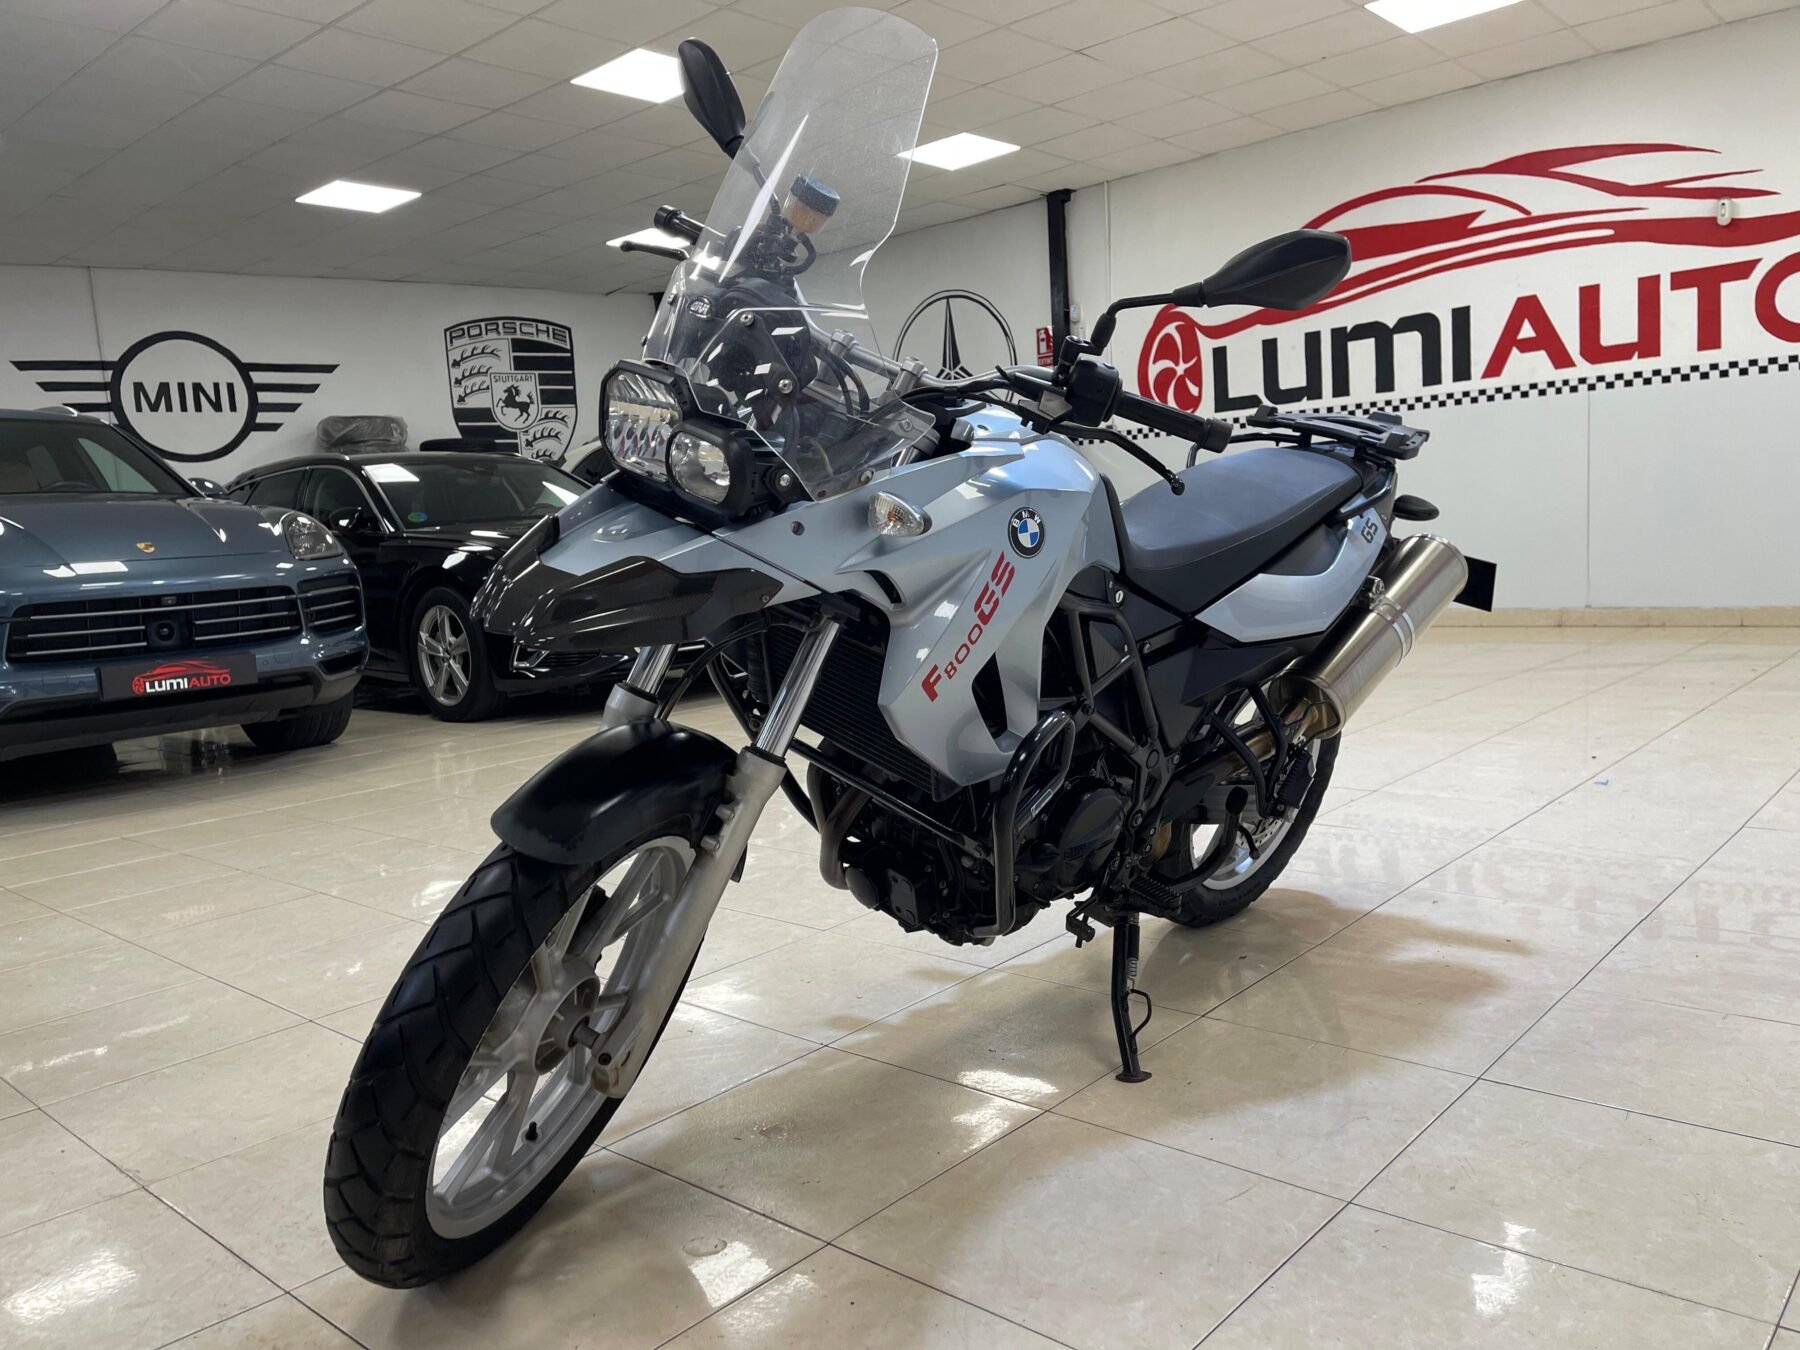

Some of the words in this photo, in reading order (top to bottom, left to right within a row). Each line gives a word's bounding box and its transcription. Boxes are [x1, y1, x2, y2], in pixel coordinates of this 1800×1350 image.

[449, 321, 568, 346] PORSCHE
[493, 374, 534, 384] STUTTGART
[133, 382, 237, 412] MINI
[1012, 510, 1041, 528] BMW
[1361, 517, 1378, 543] GS
